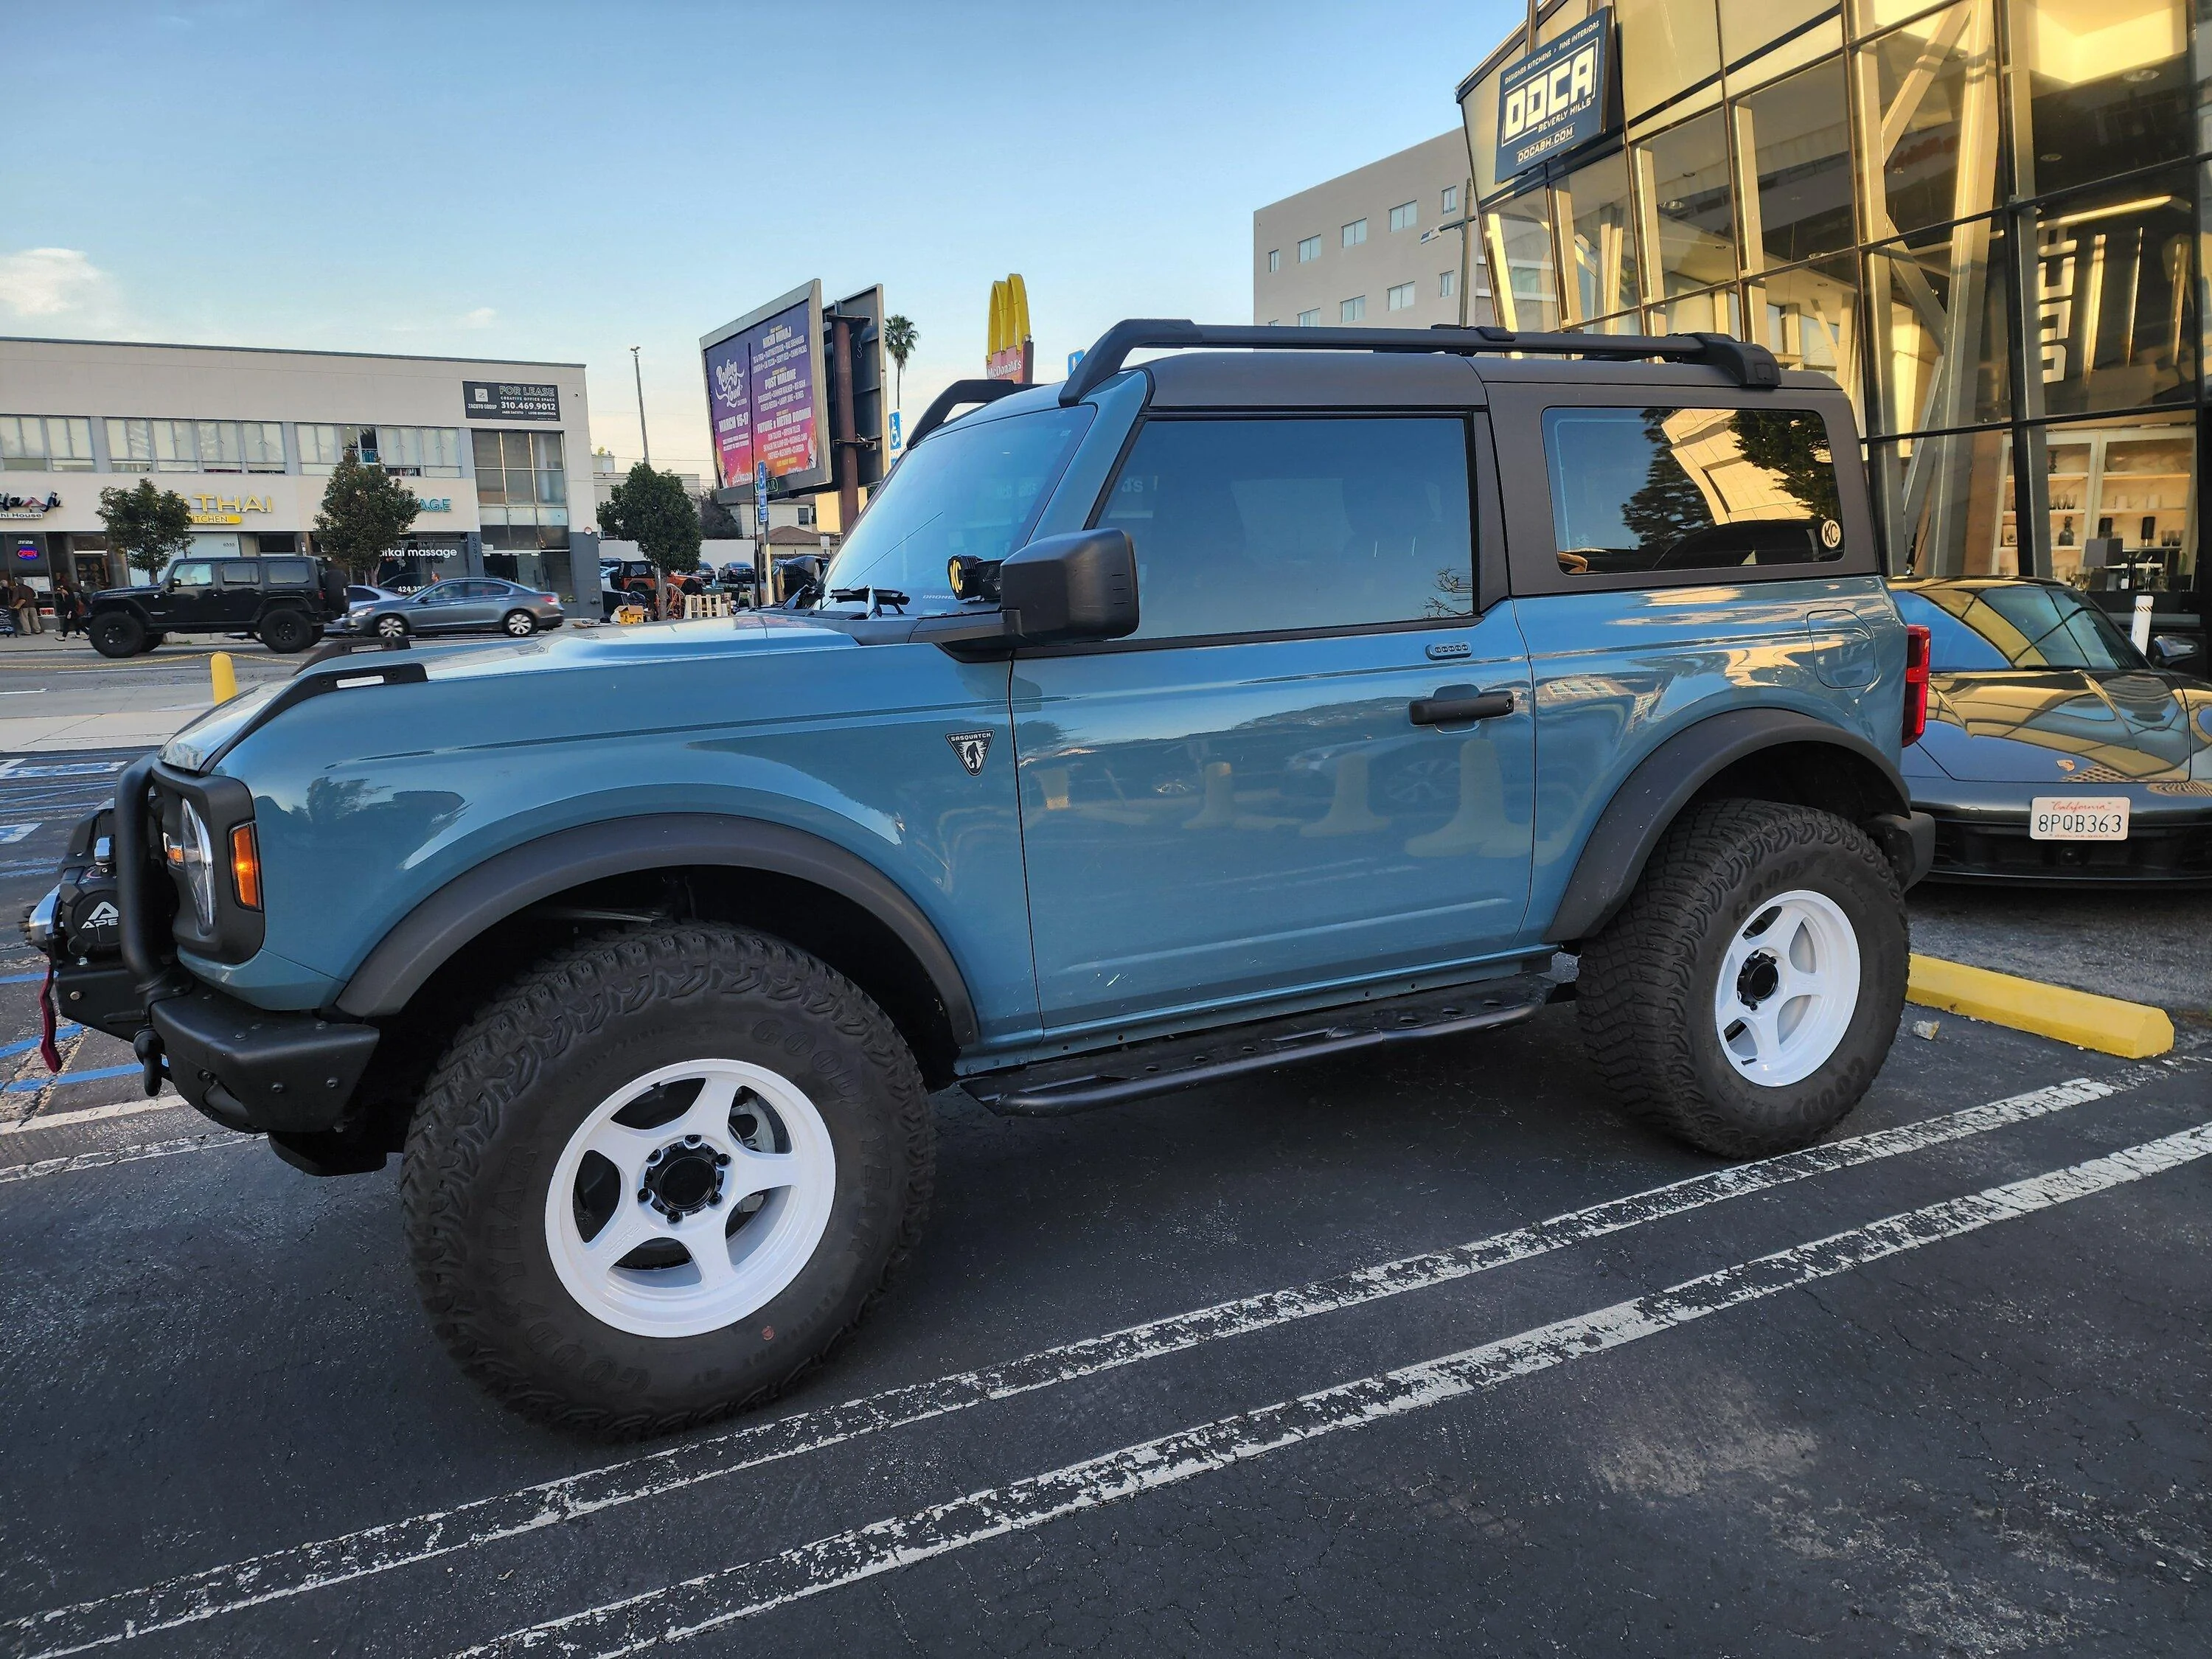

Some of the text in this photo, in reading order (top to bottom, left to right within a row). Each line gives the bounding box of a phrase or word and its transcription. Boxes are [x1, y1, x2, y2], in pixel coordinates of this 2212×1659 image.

[1505, 20, 1599, 85] DESIGNER KITCHENS FINE INTERIORS
[1505, 46, 1594, 139] DOCA
[1537, 97, 1591, 133] BEVERLY HILLS
[1518, 126, 1573, 162] DOCABH.COM
[716, 359, 745, 392] Rolling
[987, 358, 1022, 379] McDonald's
[499, 386, 554, 397] FOR LEASE
[765, 375, 776, 390] POST
[501, 402, 556, 411] 310.469.9012
[719, 412, 748, 433] MARCH 15-17
[192, 493, 272, 513] THAI
[1824, 522, 1838, 546] KC
[408, 549, 458, 559] massage
[950, 732, 991, 742] SASQUATCH
[2052, 801, 2111, 813] California
[2038, 814, 2122, 833] 8PQB363
[81, 918, 119, 929] APE
